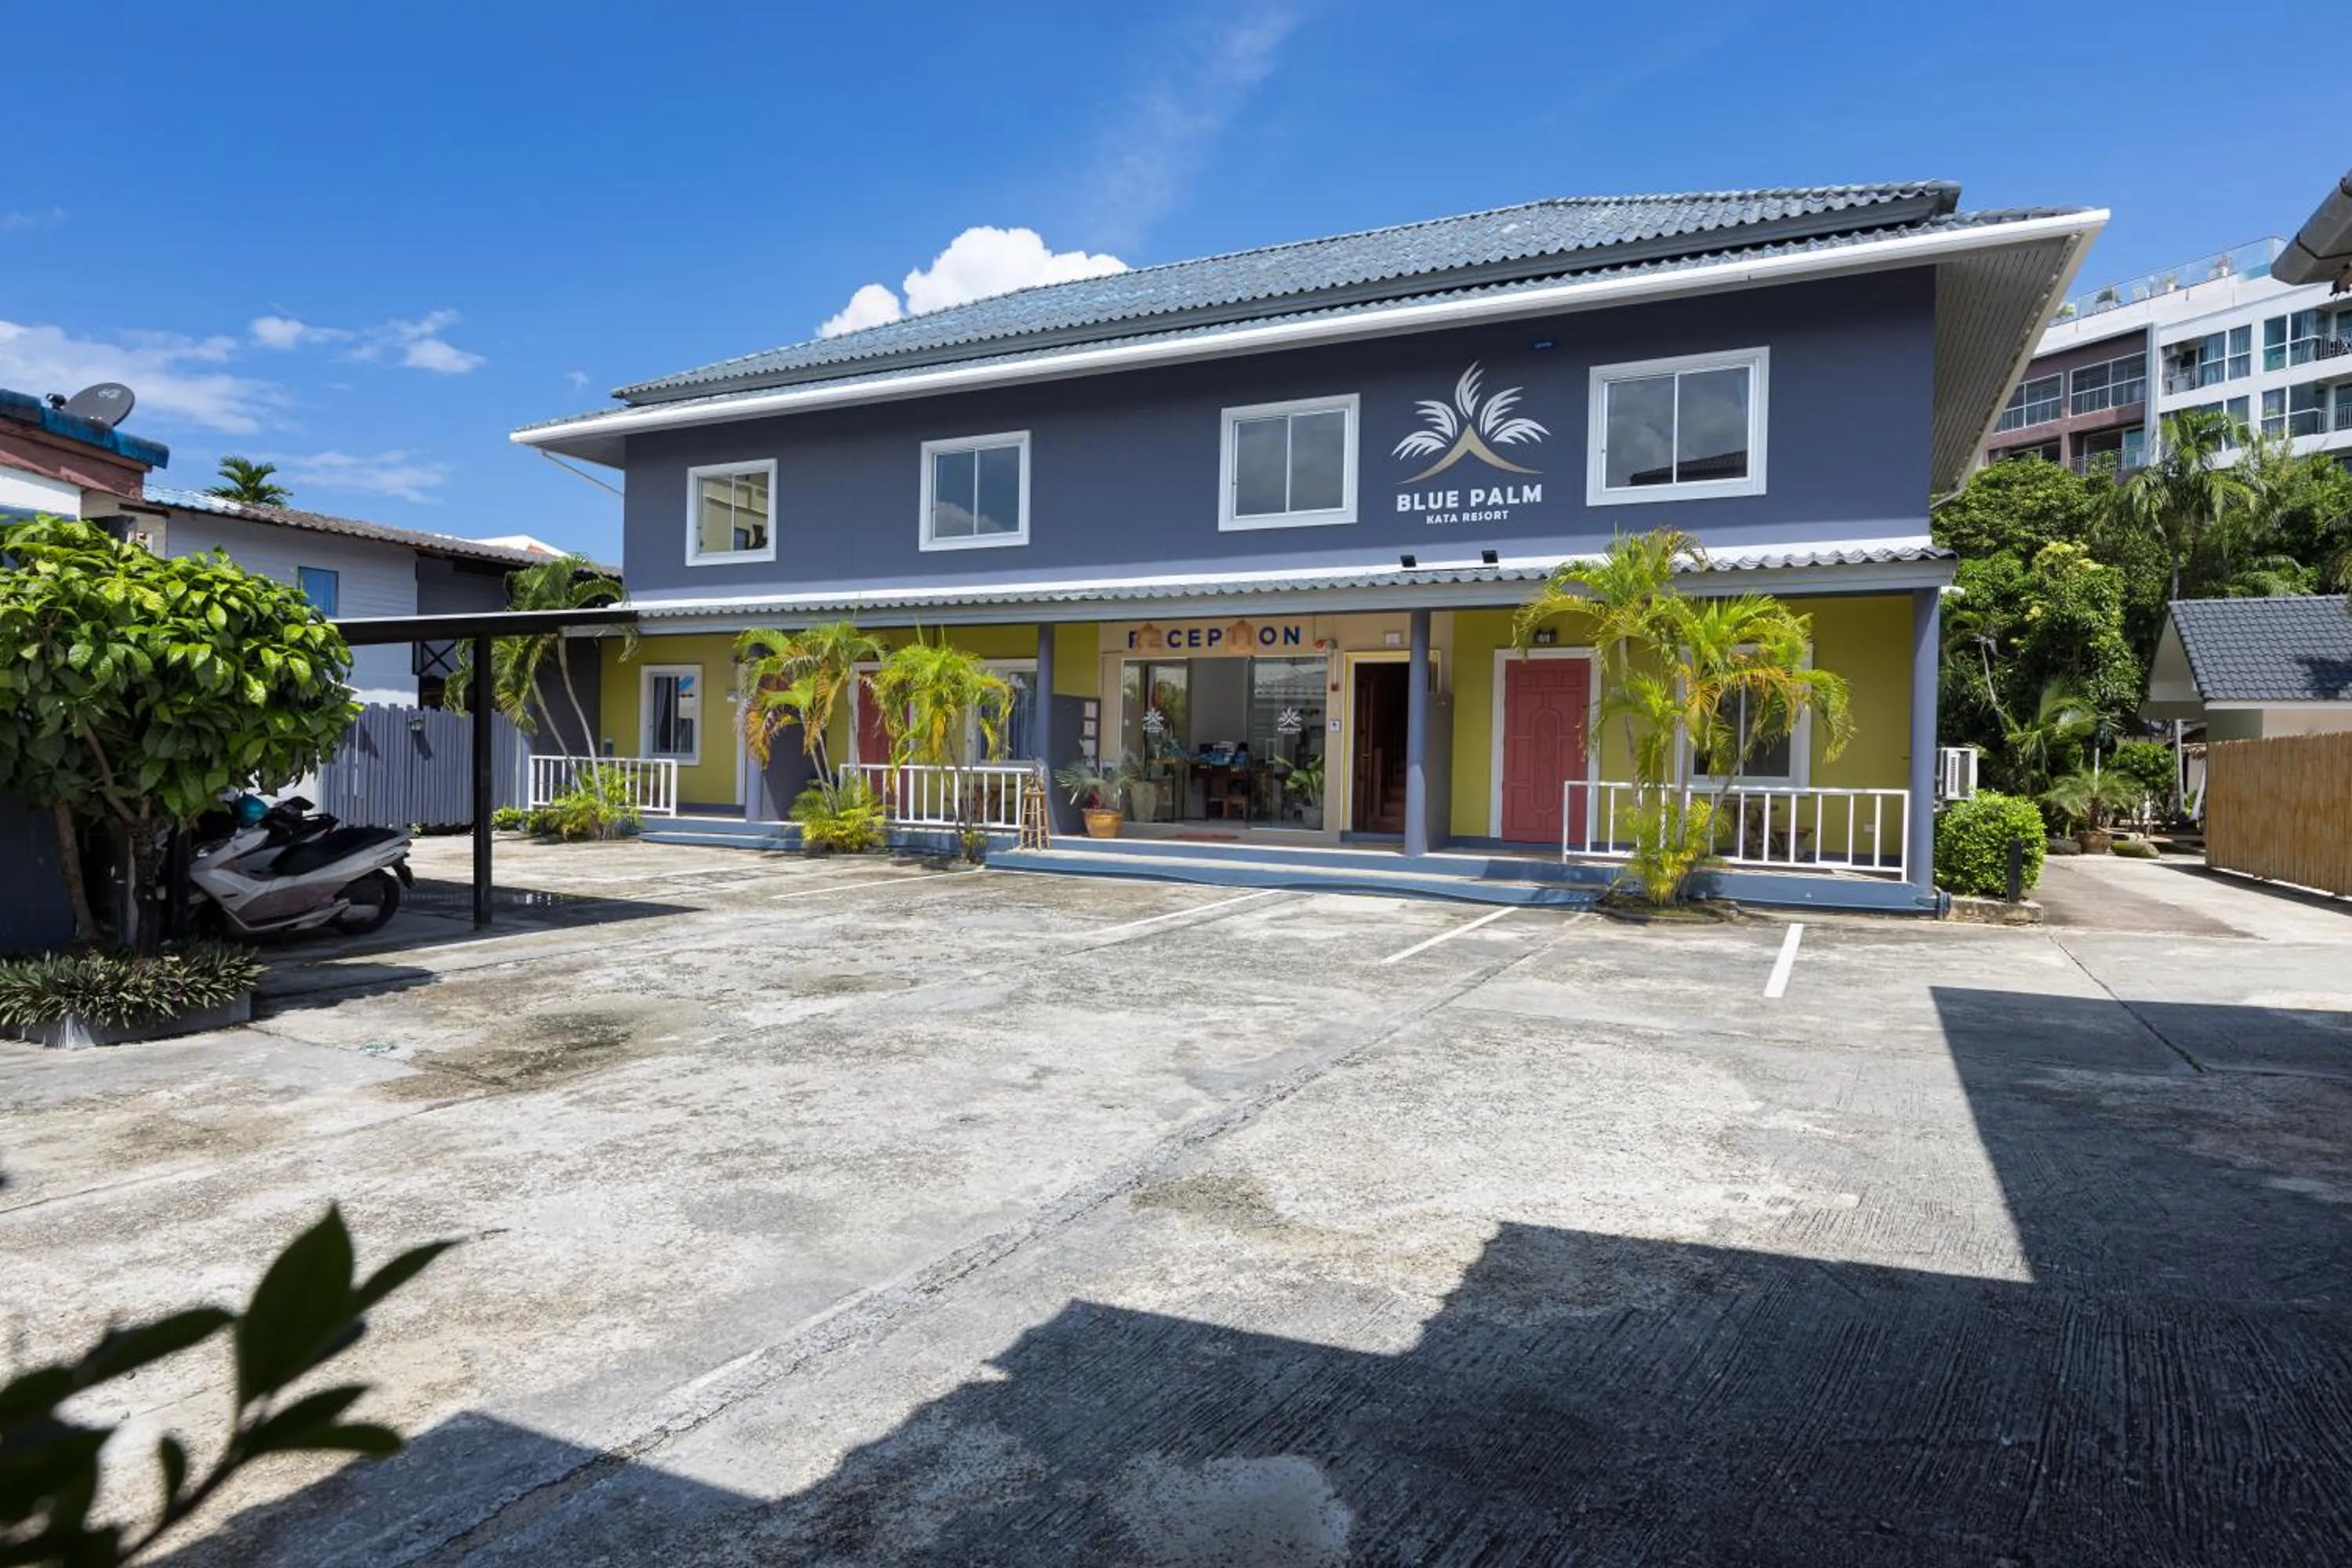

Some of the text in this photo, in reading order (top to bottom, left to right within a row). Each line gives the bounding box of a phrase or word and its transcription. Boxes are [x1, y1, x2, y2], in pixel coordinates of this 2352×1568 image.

[1396, 484, 1542, 512] BLUE PALM
[1426, 510, 1509, 524] KATA RESORT
[1128, 626, 1301, 649] RCEPON
